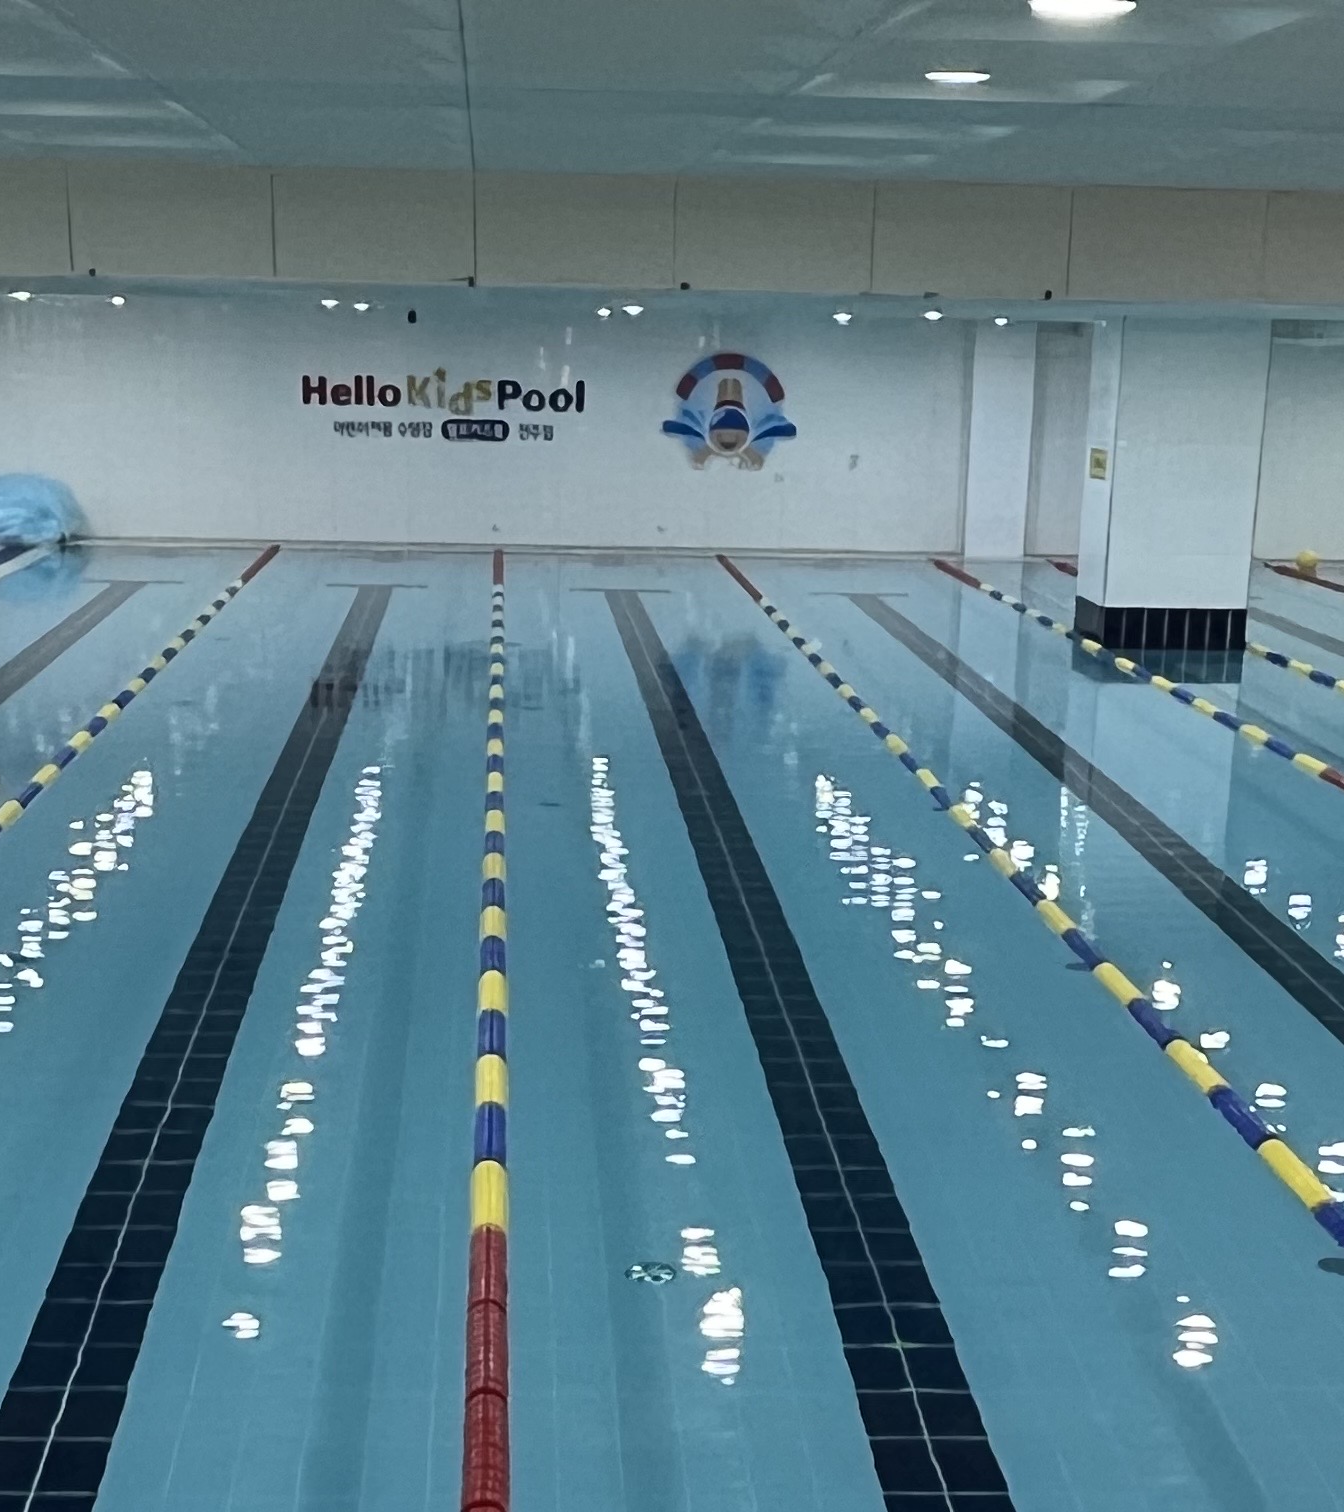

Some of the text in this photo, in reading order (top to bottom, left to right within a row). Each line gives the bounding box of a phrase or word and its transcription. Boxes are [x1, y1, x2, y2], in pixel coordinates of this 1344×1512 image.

[302, 366, 586, 415] Hello Kids Pool
